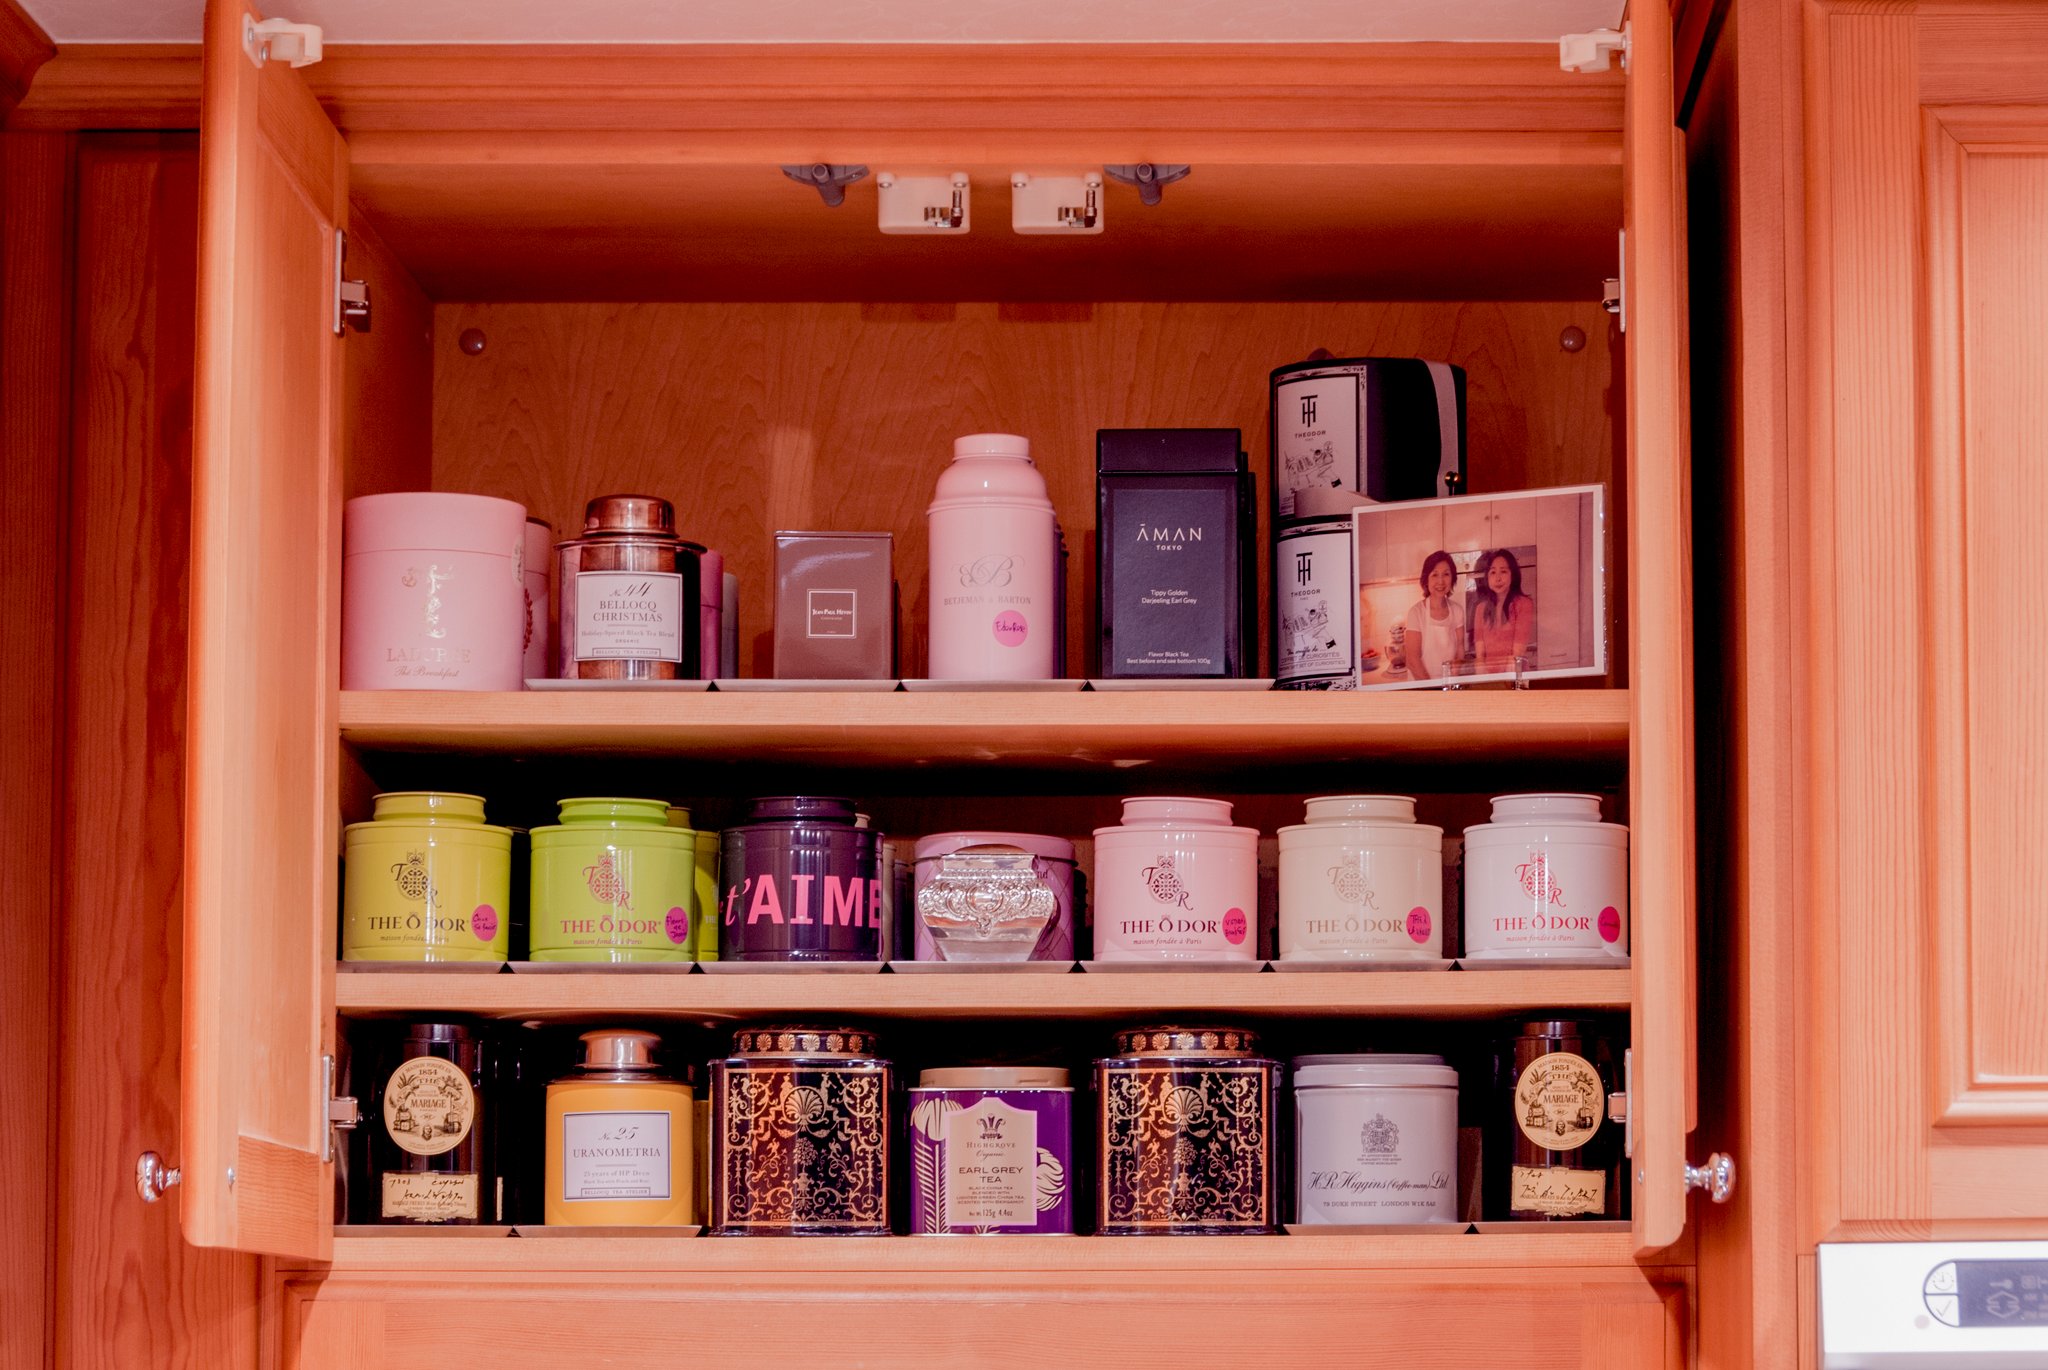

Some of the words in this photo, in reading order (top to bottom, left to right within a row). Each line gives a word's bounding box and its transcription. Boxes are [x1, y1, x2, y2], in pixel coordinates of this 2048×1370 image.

[1294, 430, 1326, 439] THEODOR
[1290, 589, 1321, 598] THEODOR
[600, 600, 656, 612] BELLOCQ
[593, 612, 663, 622] CHRISTMAS
[1155, 938, 1177, 946] fondée
[1544, 1094, 1579, 1103] MARIAGE
[411, 1099, 447, 1108] MARIAGE
[614, 1126, 639, 1140] 25
[572, 1148, 661, 1158] URANOMETRIA
[1340, 1170, 1386, 1193] Higgins
[983, 1209, 996, 1218] 125g
